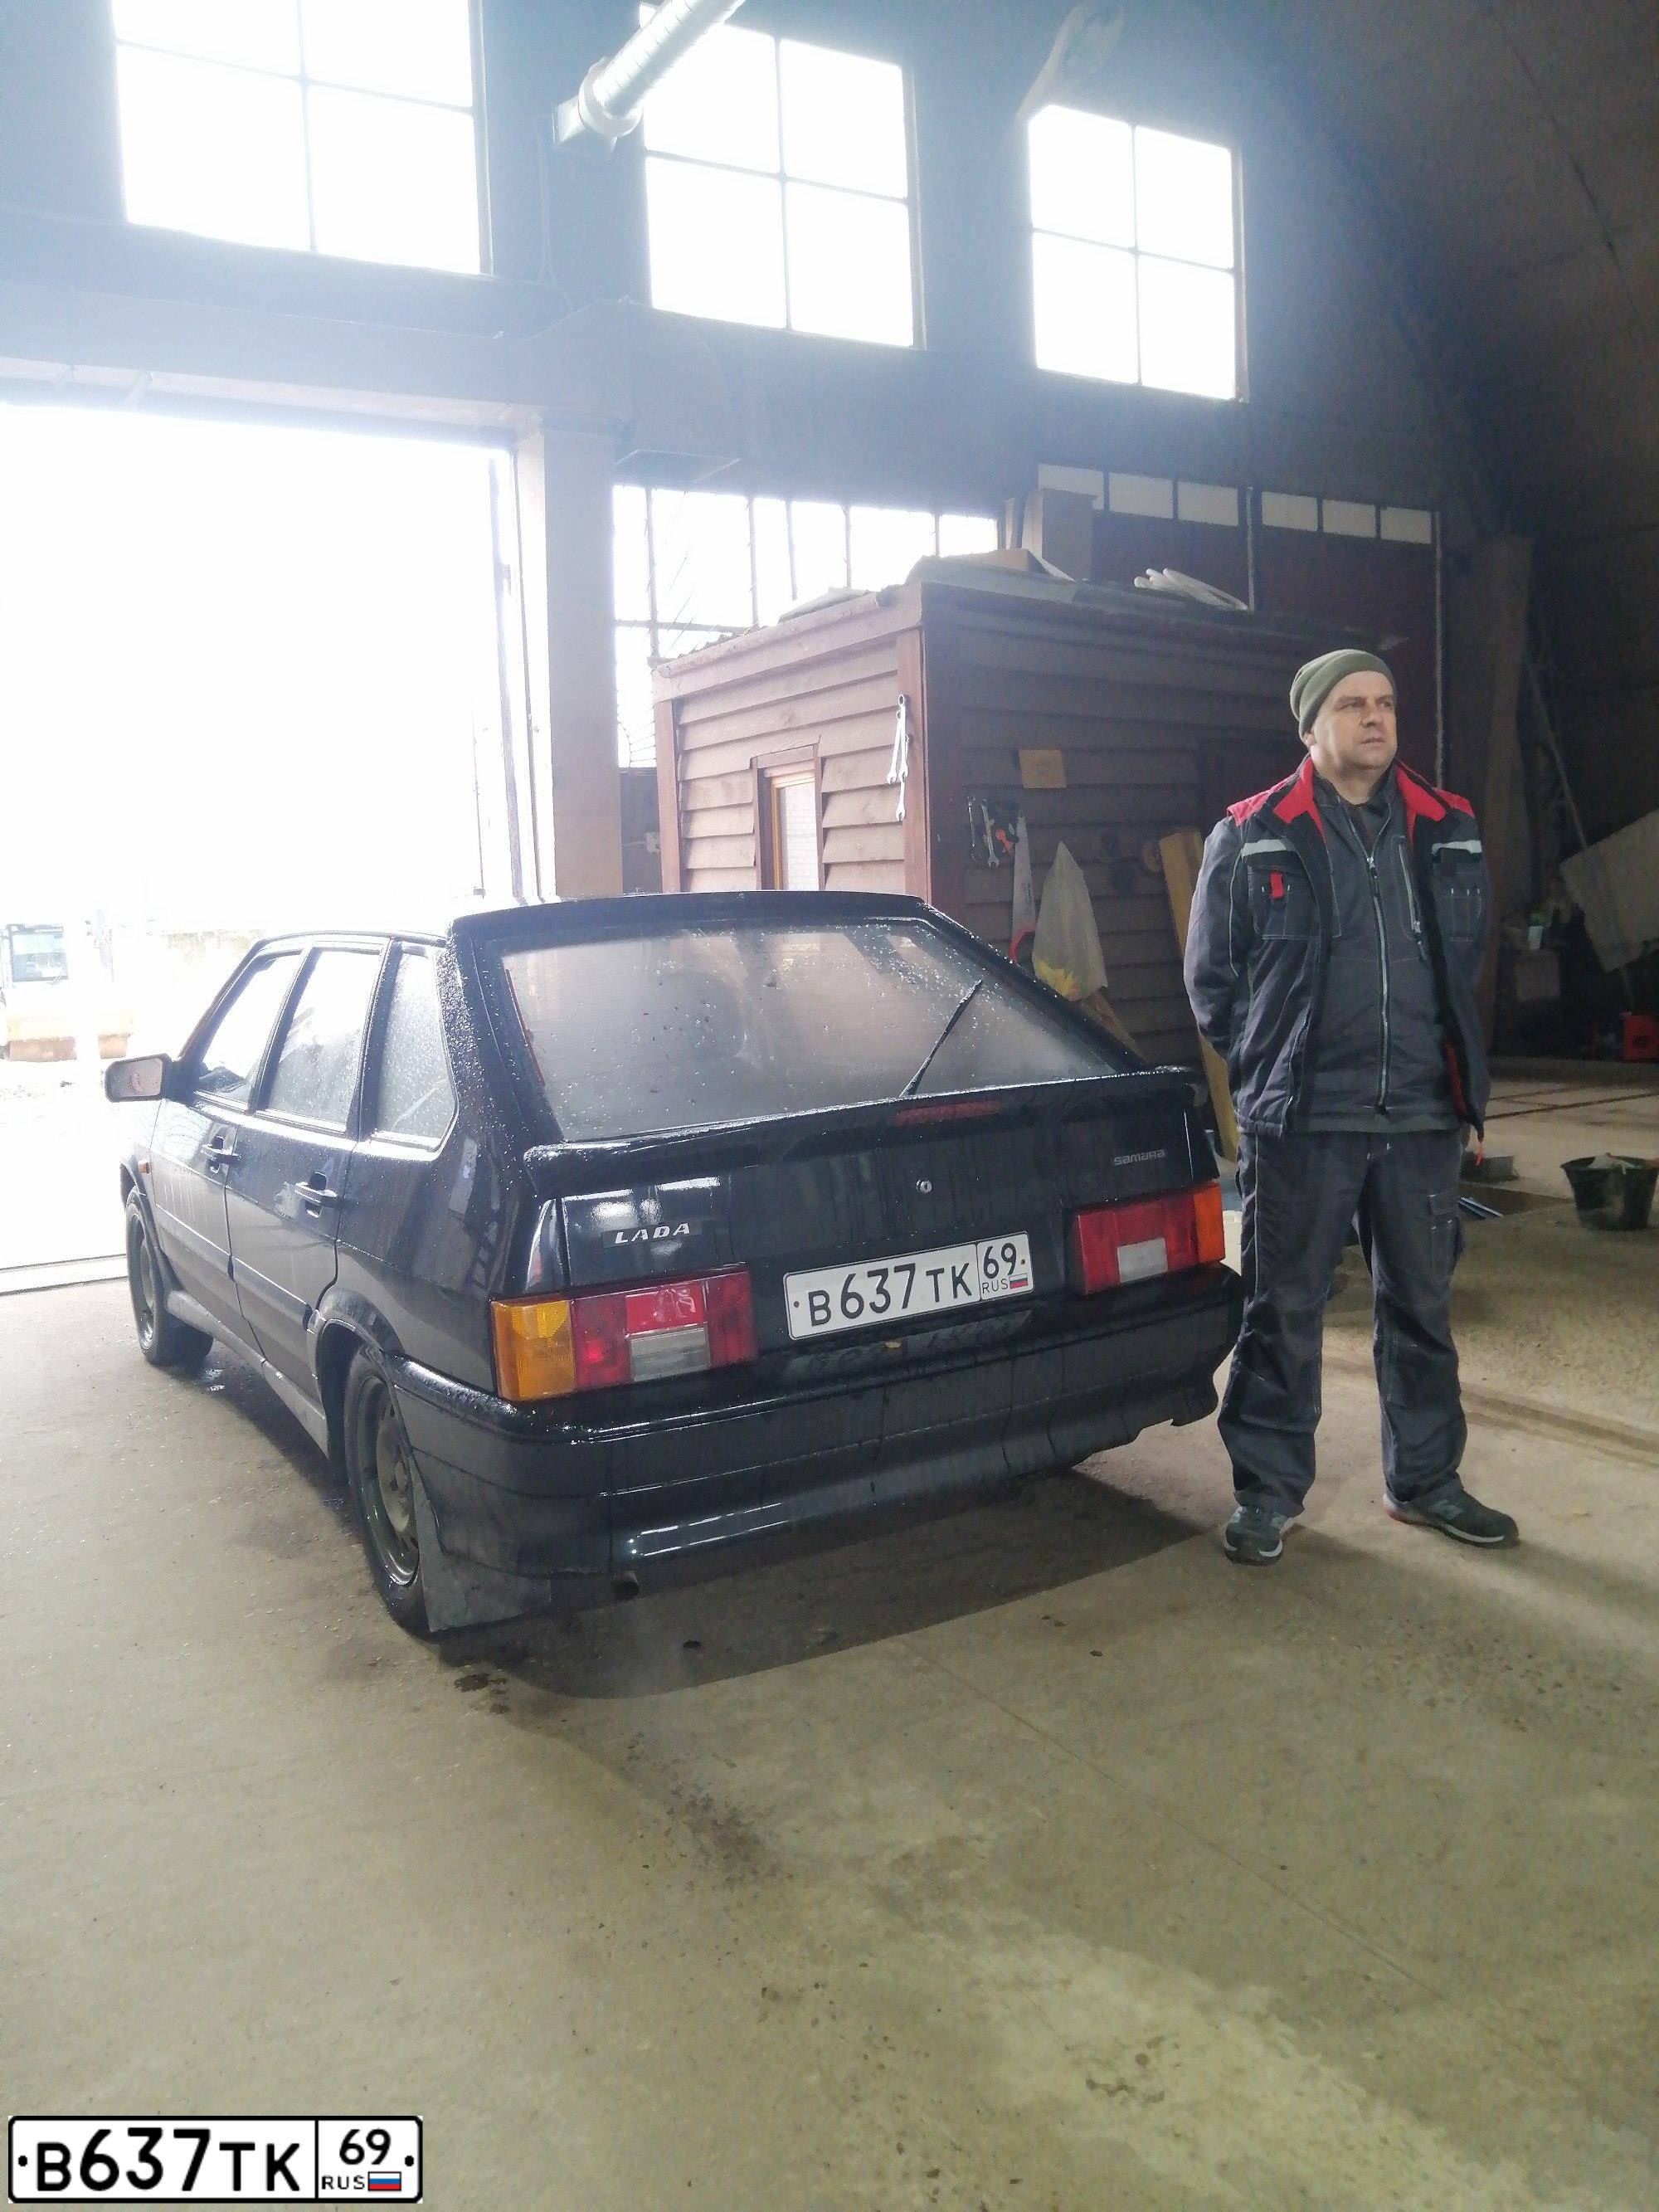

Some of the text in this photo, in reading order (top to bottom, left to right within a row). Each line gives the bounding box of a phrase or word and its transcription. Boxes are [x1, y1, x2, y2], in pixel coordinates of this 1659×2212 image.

[615, 1222, 690, 1244] LADA
[983, 1242, 1017, 1279] 69
[981, 1278, 1009, 1294] RUS
